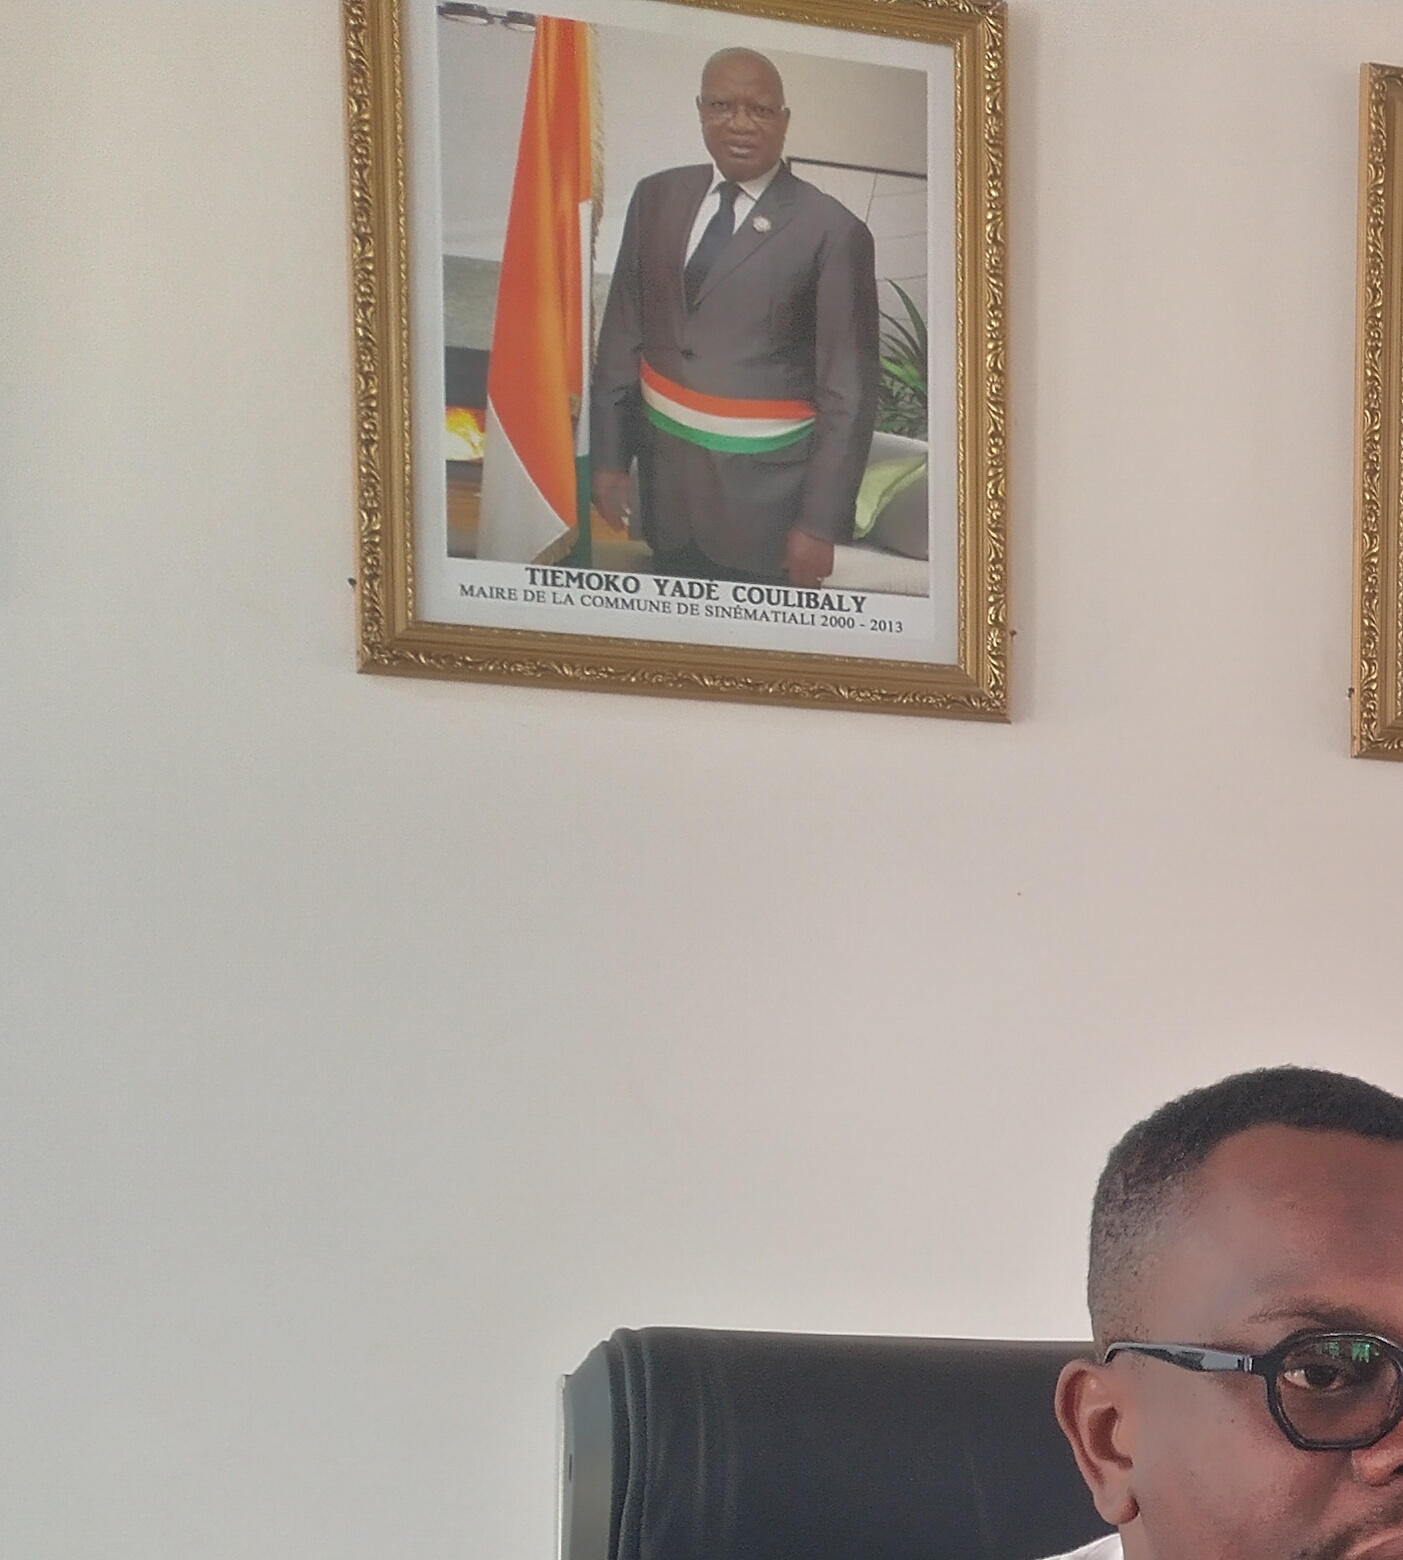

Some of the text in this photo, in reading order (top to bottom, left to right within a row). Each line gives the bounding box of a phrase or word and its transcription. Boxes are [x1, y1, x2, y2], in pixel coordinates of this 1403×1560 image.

[459, 584, 518, 602] MAIRE
[522, 588, 547, 604] DE
[551, 590, 574, 606] LA
[580, 592, 672, 614] COMMUNE
[676, 600, 700, 616] DE
[705, 602, 816, 627] SINÉMATIALI
[820, 614, 855, 630] 2000
[870, 618, 904, 634] 2013
[525, 566, 641, 595] TIEMOKO
[731, 584, 867, 614] COULIBALY
